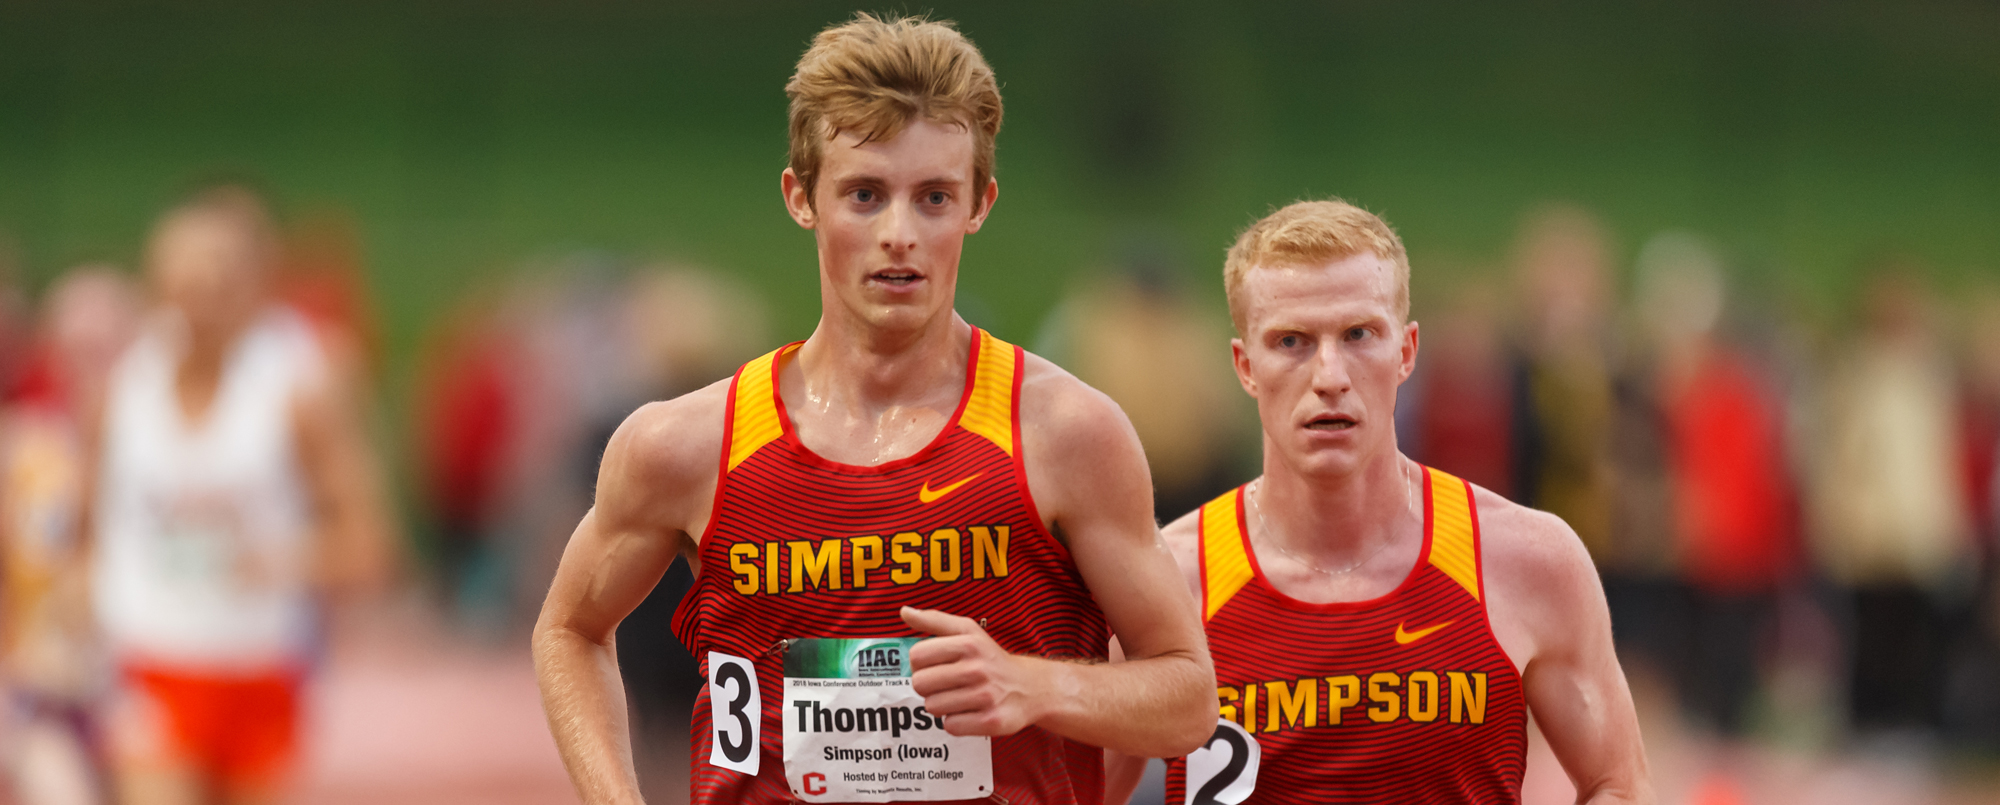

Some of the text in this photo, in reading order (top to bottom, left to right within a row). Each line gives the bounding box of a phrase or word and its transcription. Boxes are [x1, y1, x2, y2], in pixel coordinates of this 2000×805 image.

[729, 525, 1011, 596] SIMPSON
[858, 649, 900, 667] IIAC
[823, 680, 857, 688] Conference
[858, 680, 883, 688] Outdoor
[885, 679, 903, 687] Track
[714, 661, 752, 763] 3
[823, 744, 949, 763] Simpson (Iowa)
[1191, 724, 1249, 805] 2
[803, 772, 827, 796] C
[843, 770, 964, 782] Hosted by Central College
